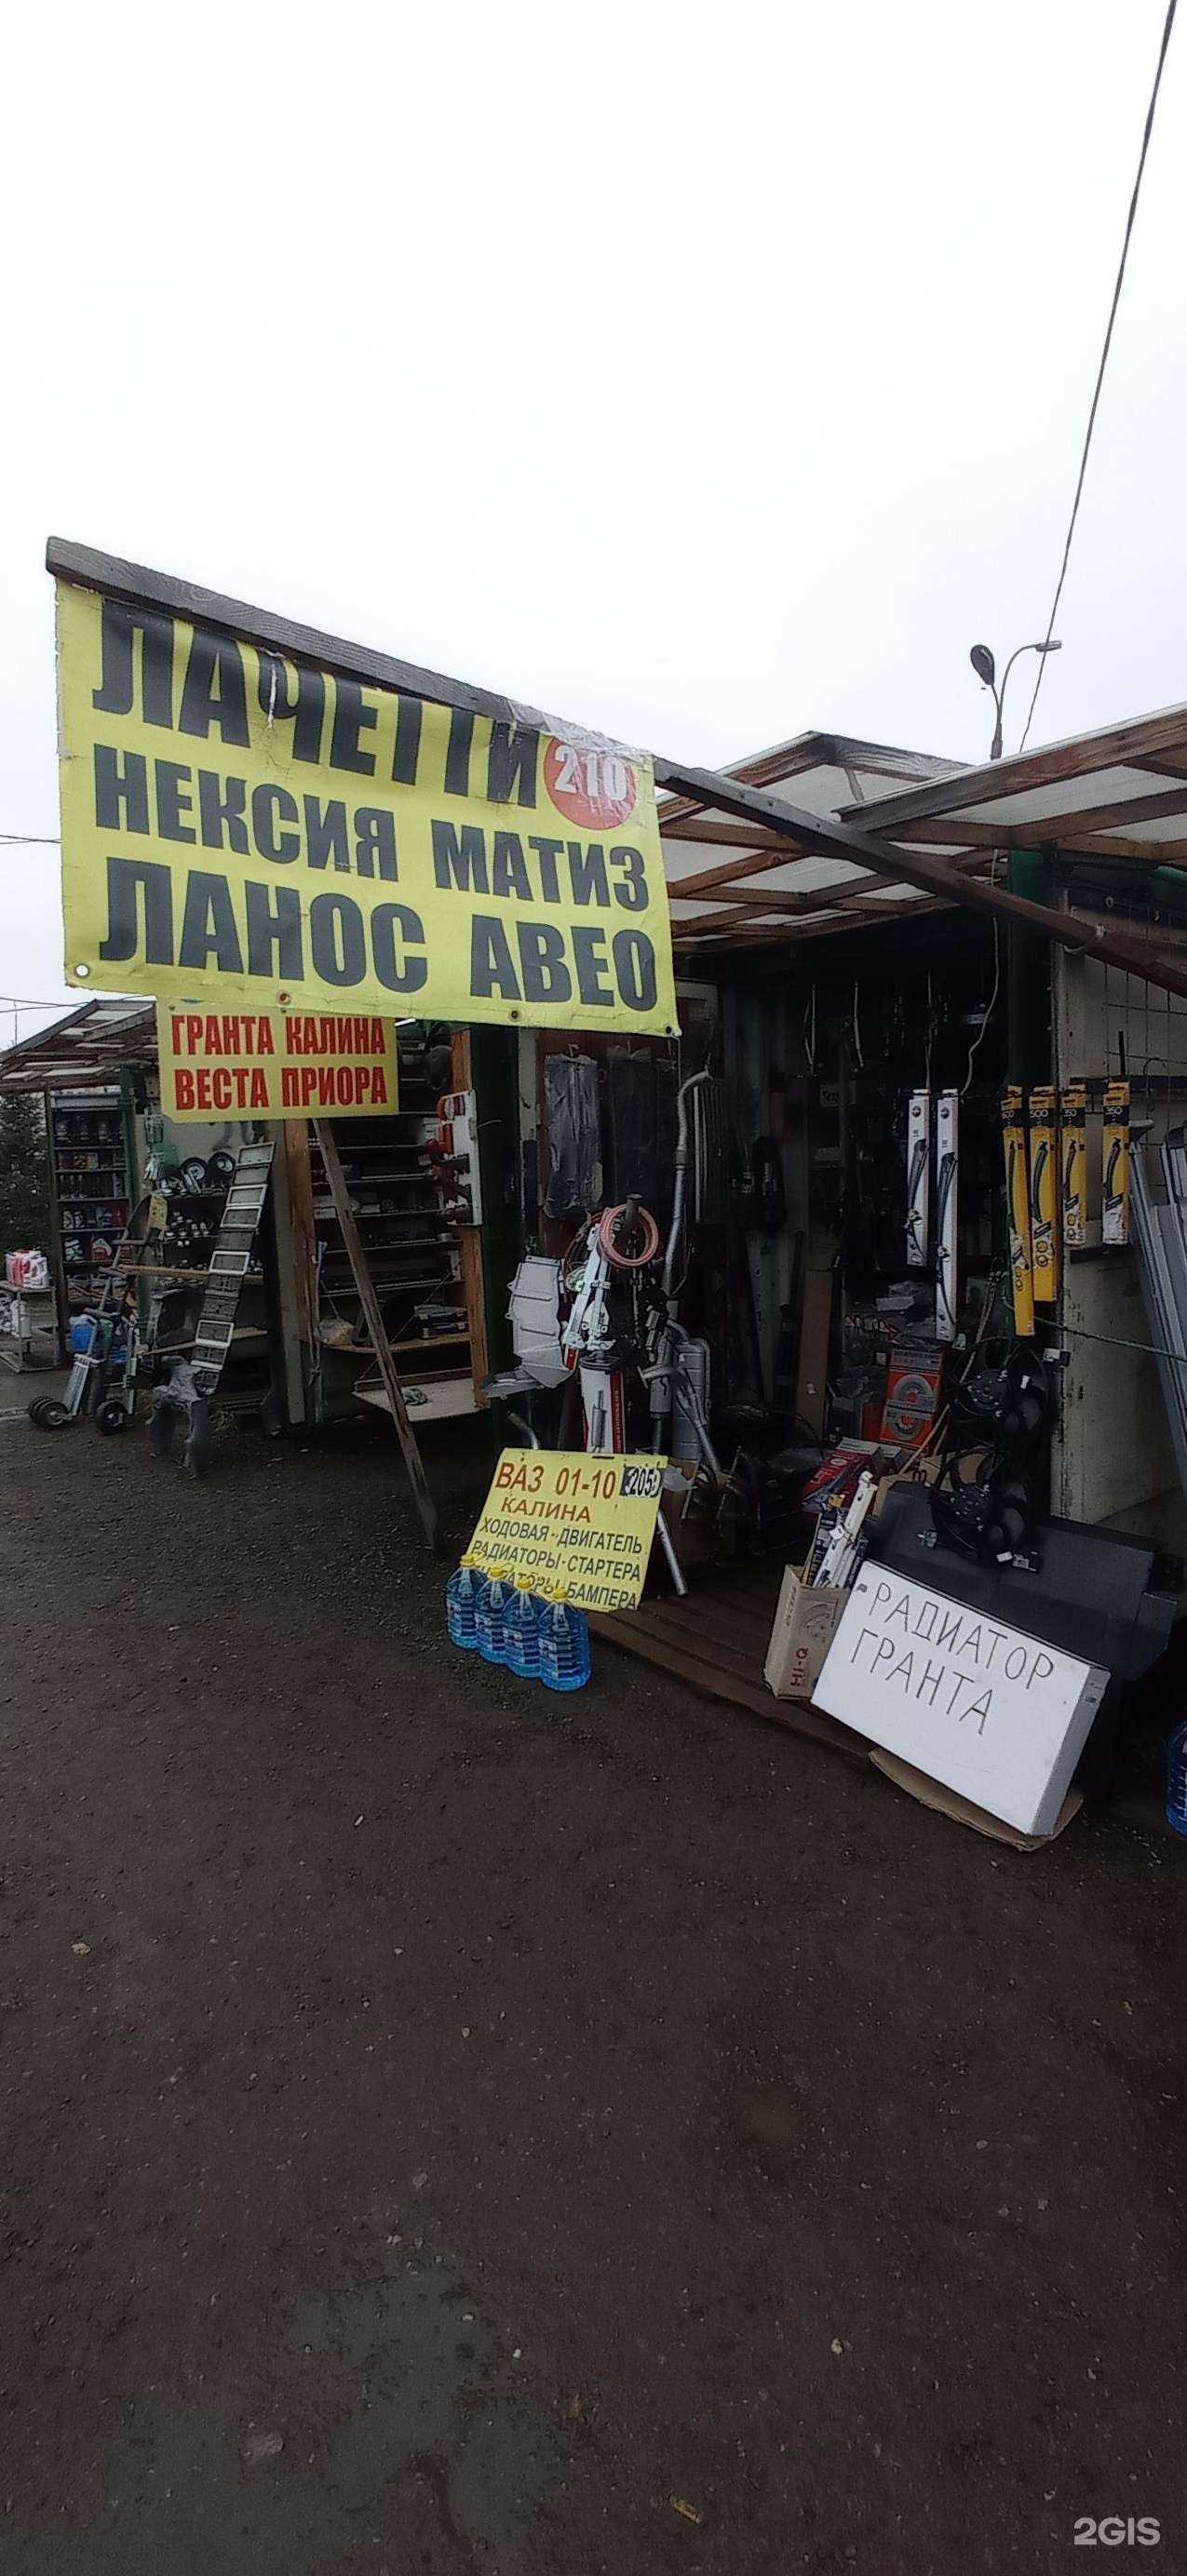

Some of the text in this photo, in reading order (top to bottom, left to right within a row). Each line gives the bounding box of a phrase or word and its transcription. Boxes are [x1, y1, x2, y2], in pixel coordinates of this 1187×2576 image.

[555, 745, 627, 801] 210
[93, 743, 650, 912] НЕКСИЯ МАТИЗ
[99, 856, 657, 1012] ЛАНОС АВЕО
[171, 1015, 386, 1055] ГРАНТА КАЛИНА
[174, 1067, 388, 1110] ВЕСТА ПРИОРА
[495, 1462, 616, 1499] ВАЗ 01-10
[501, 1496, 591, 1523] КАЛИНА
[480, 1516, 549, 1542] ХОДОВАЯ
[558, 1527, 642, 1554] ДВИГАТЕЛЬ
[868, 1582, 1054, 1689] РАДИАТОР
[850, 1628, 994, 1736] ГРАНТА
